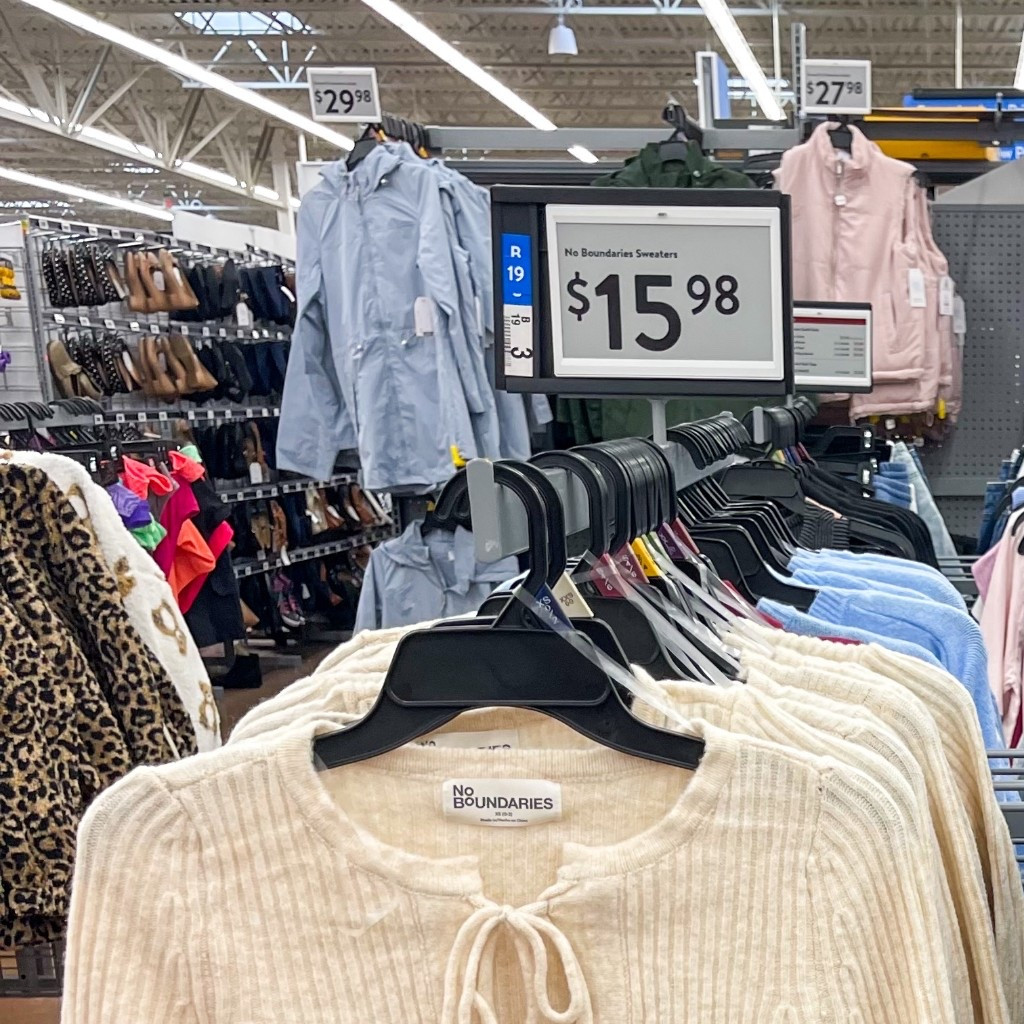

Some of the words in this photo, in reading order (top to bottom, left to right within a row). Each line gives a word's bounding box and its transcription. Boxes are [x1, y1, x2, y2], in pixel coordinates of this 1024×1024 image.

[510, 245, 522, 259] R
[564, 248, 579, 258] No
[581, 248, 634, 259] Boundaries
[636, 249, 678, 259] Sweaters
[507, 265, 525, 282] 19
[566, 271, 740, 352] $1598
[511, 313, 521, 326] 19
[510, 347, 533, 359] 3
[452, 784, 474, 797] No
[453, 796, 554, 810] BOUNDARIES
